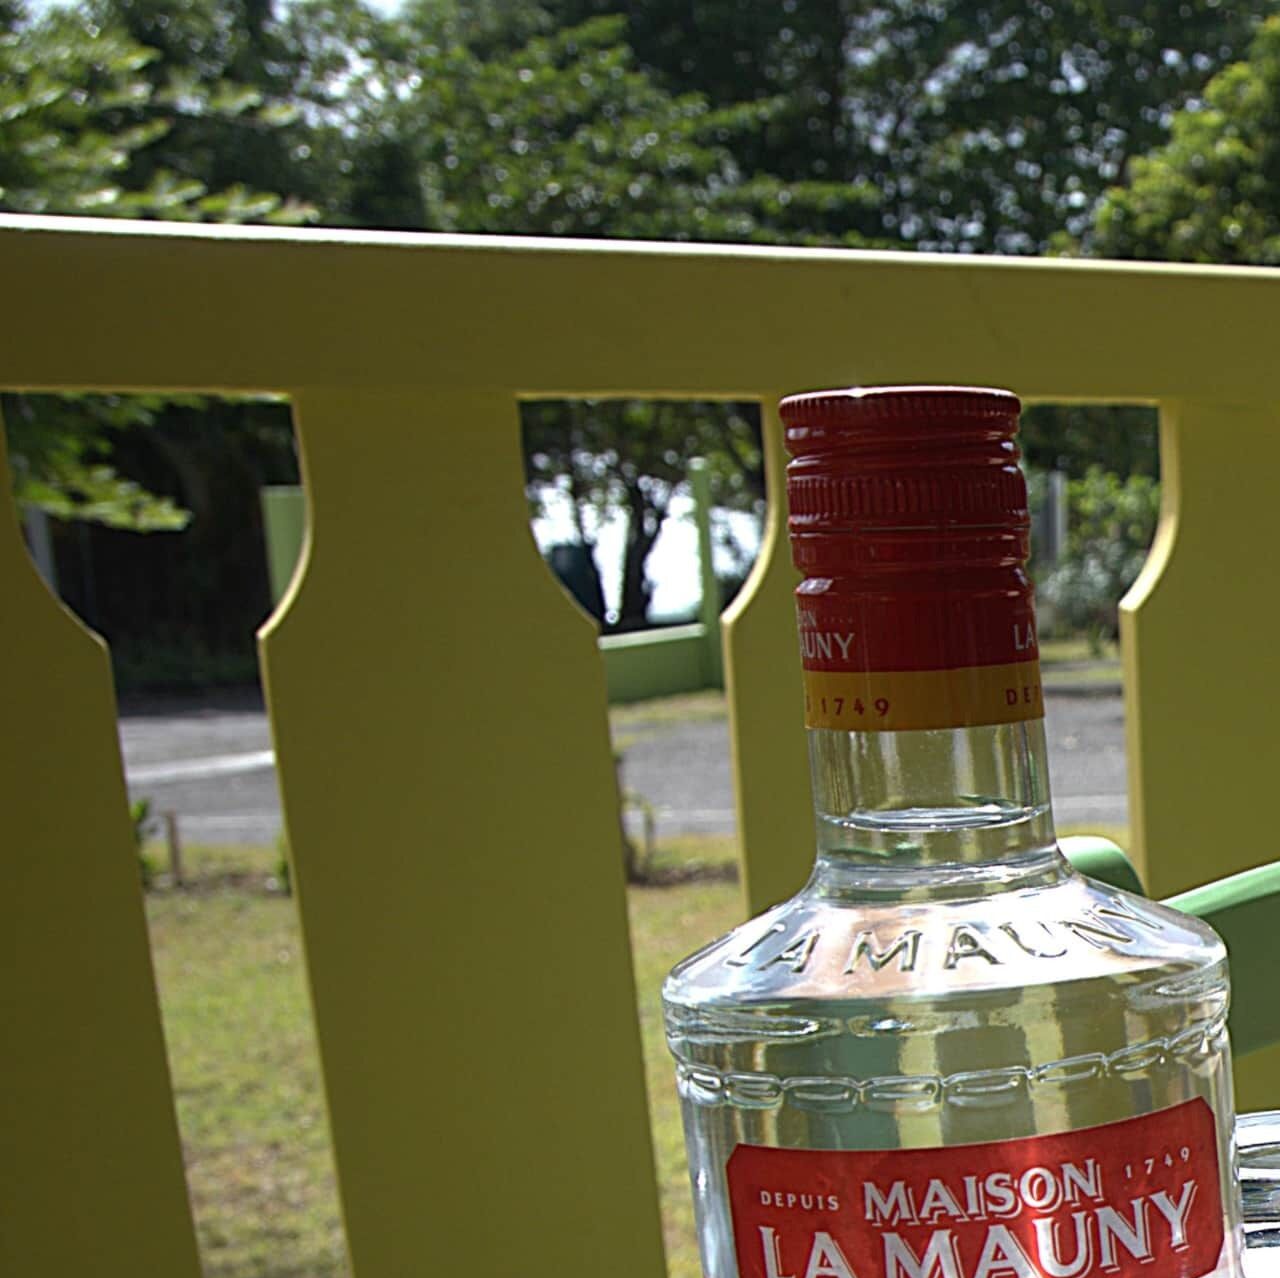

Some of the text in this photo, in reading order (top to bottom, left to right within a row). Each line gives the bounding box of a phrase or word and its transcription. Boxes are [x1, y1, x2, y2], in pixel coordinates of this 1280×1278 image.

[821, 697, 890, 717] 1749
[760, 1146, 1191, 1226] DEPUIS MAISON 1749
